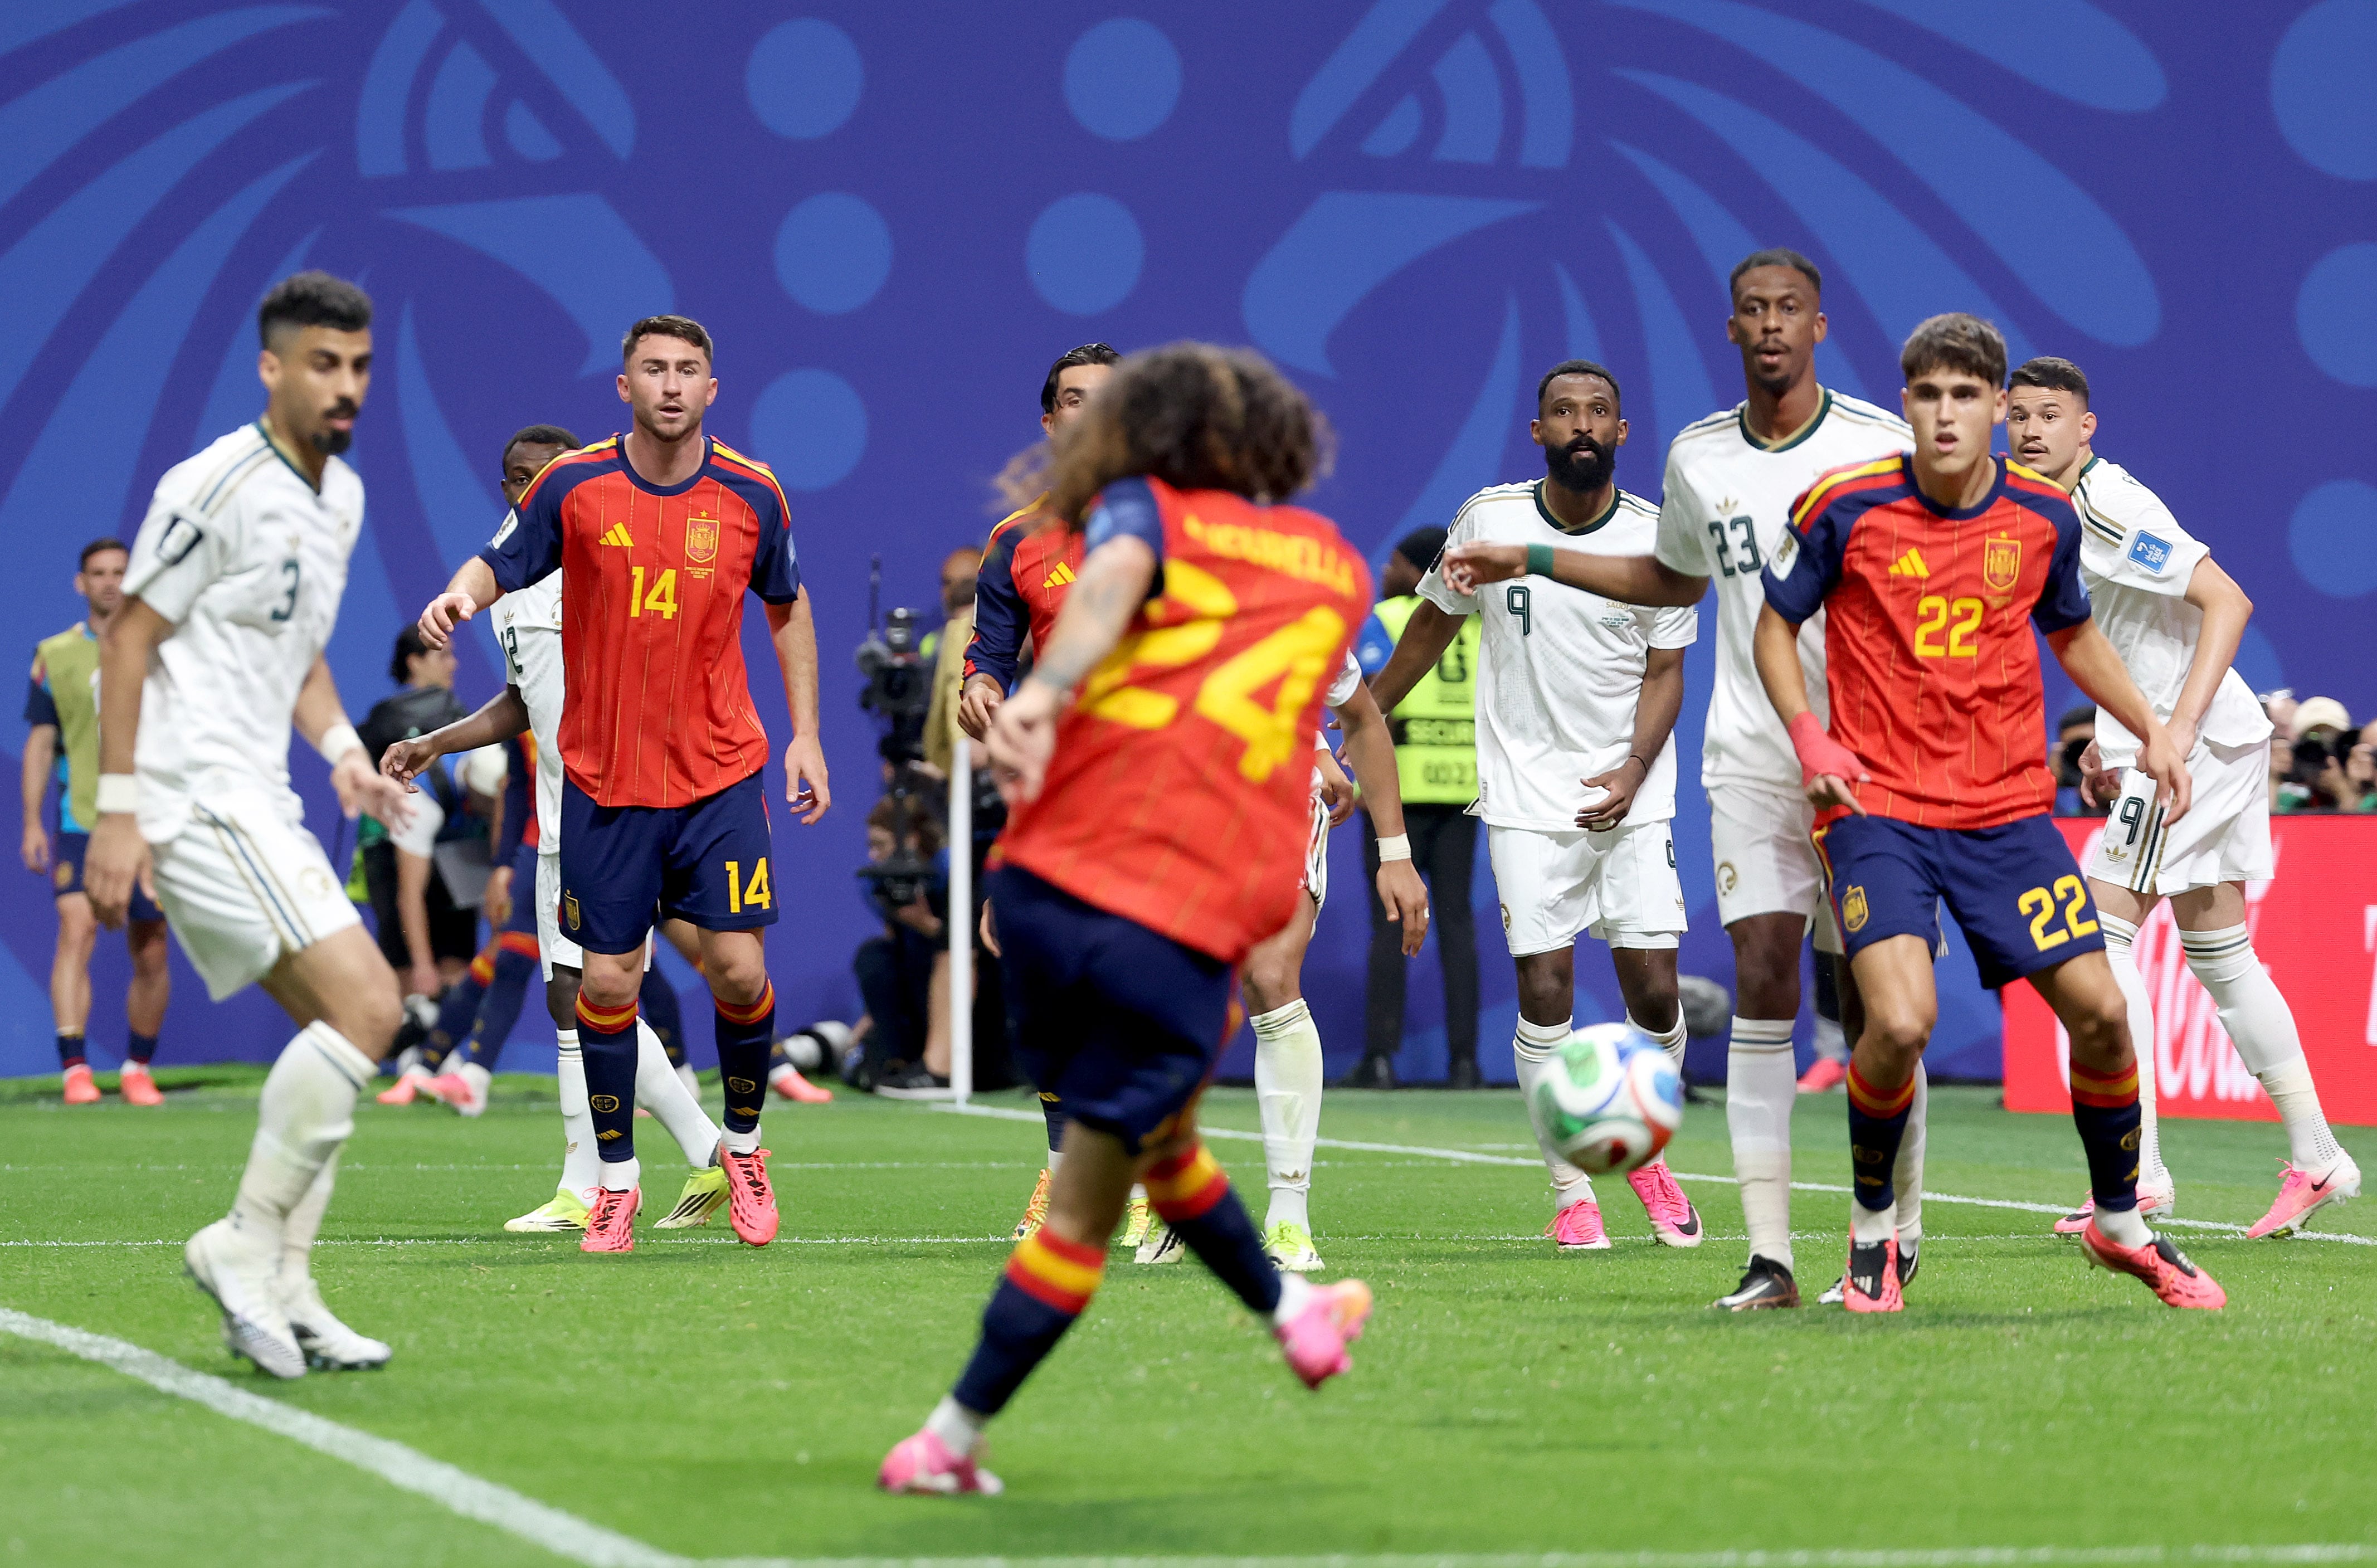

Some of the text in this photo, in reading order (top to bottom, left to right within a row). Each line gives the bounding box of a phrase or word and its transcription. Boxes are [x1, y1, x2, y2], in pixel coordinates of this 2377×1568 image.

[1708, 516, 1761, 577] 23
[271, 558, 300, 621] 3
[630, 566, 678, 620] 14
[1507, 586, 1532, 637] 9
[1915, 595, 1984, 656] 22
[1081, 557, 1346, 783] 24
[2111, 796, 2145, 846] 9
[725, 857, 772, 913] 14
[2018, 874, 2100, 952] 22
